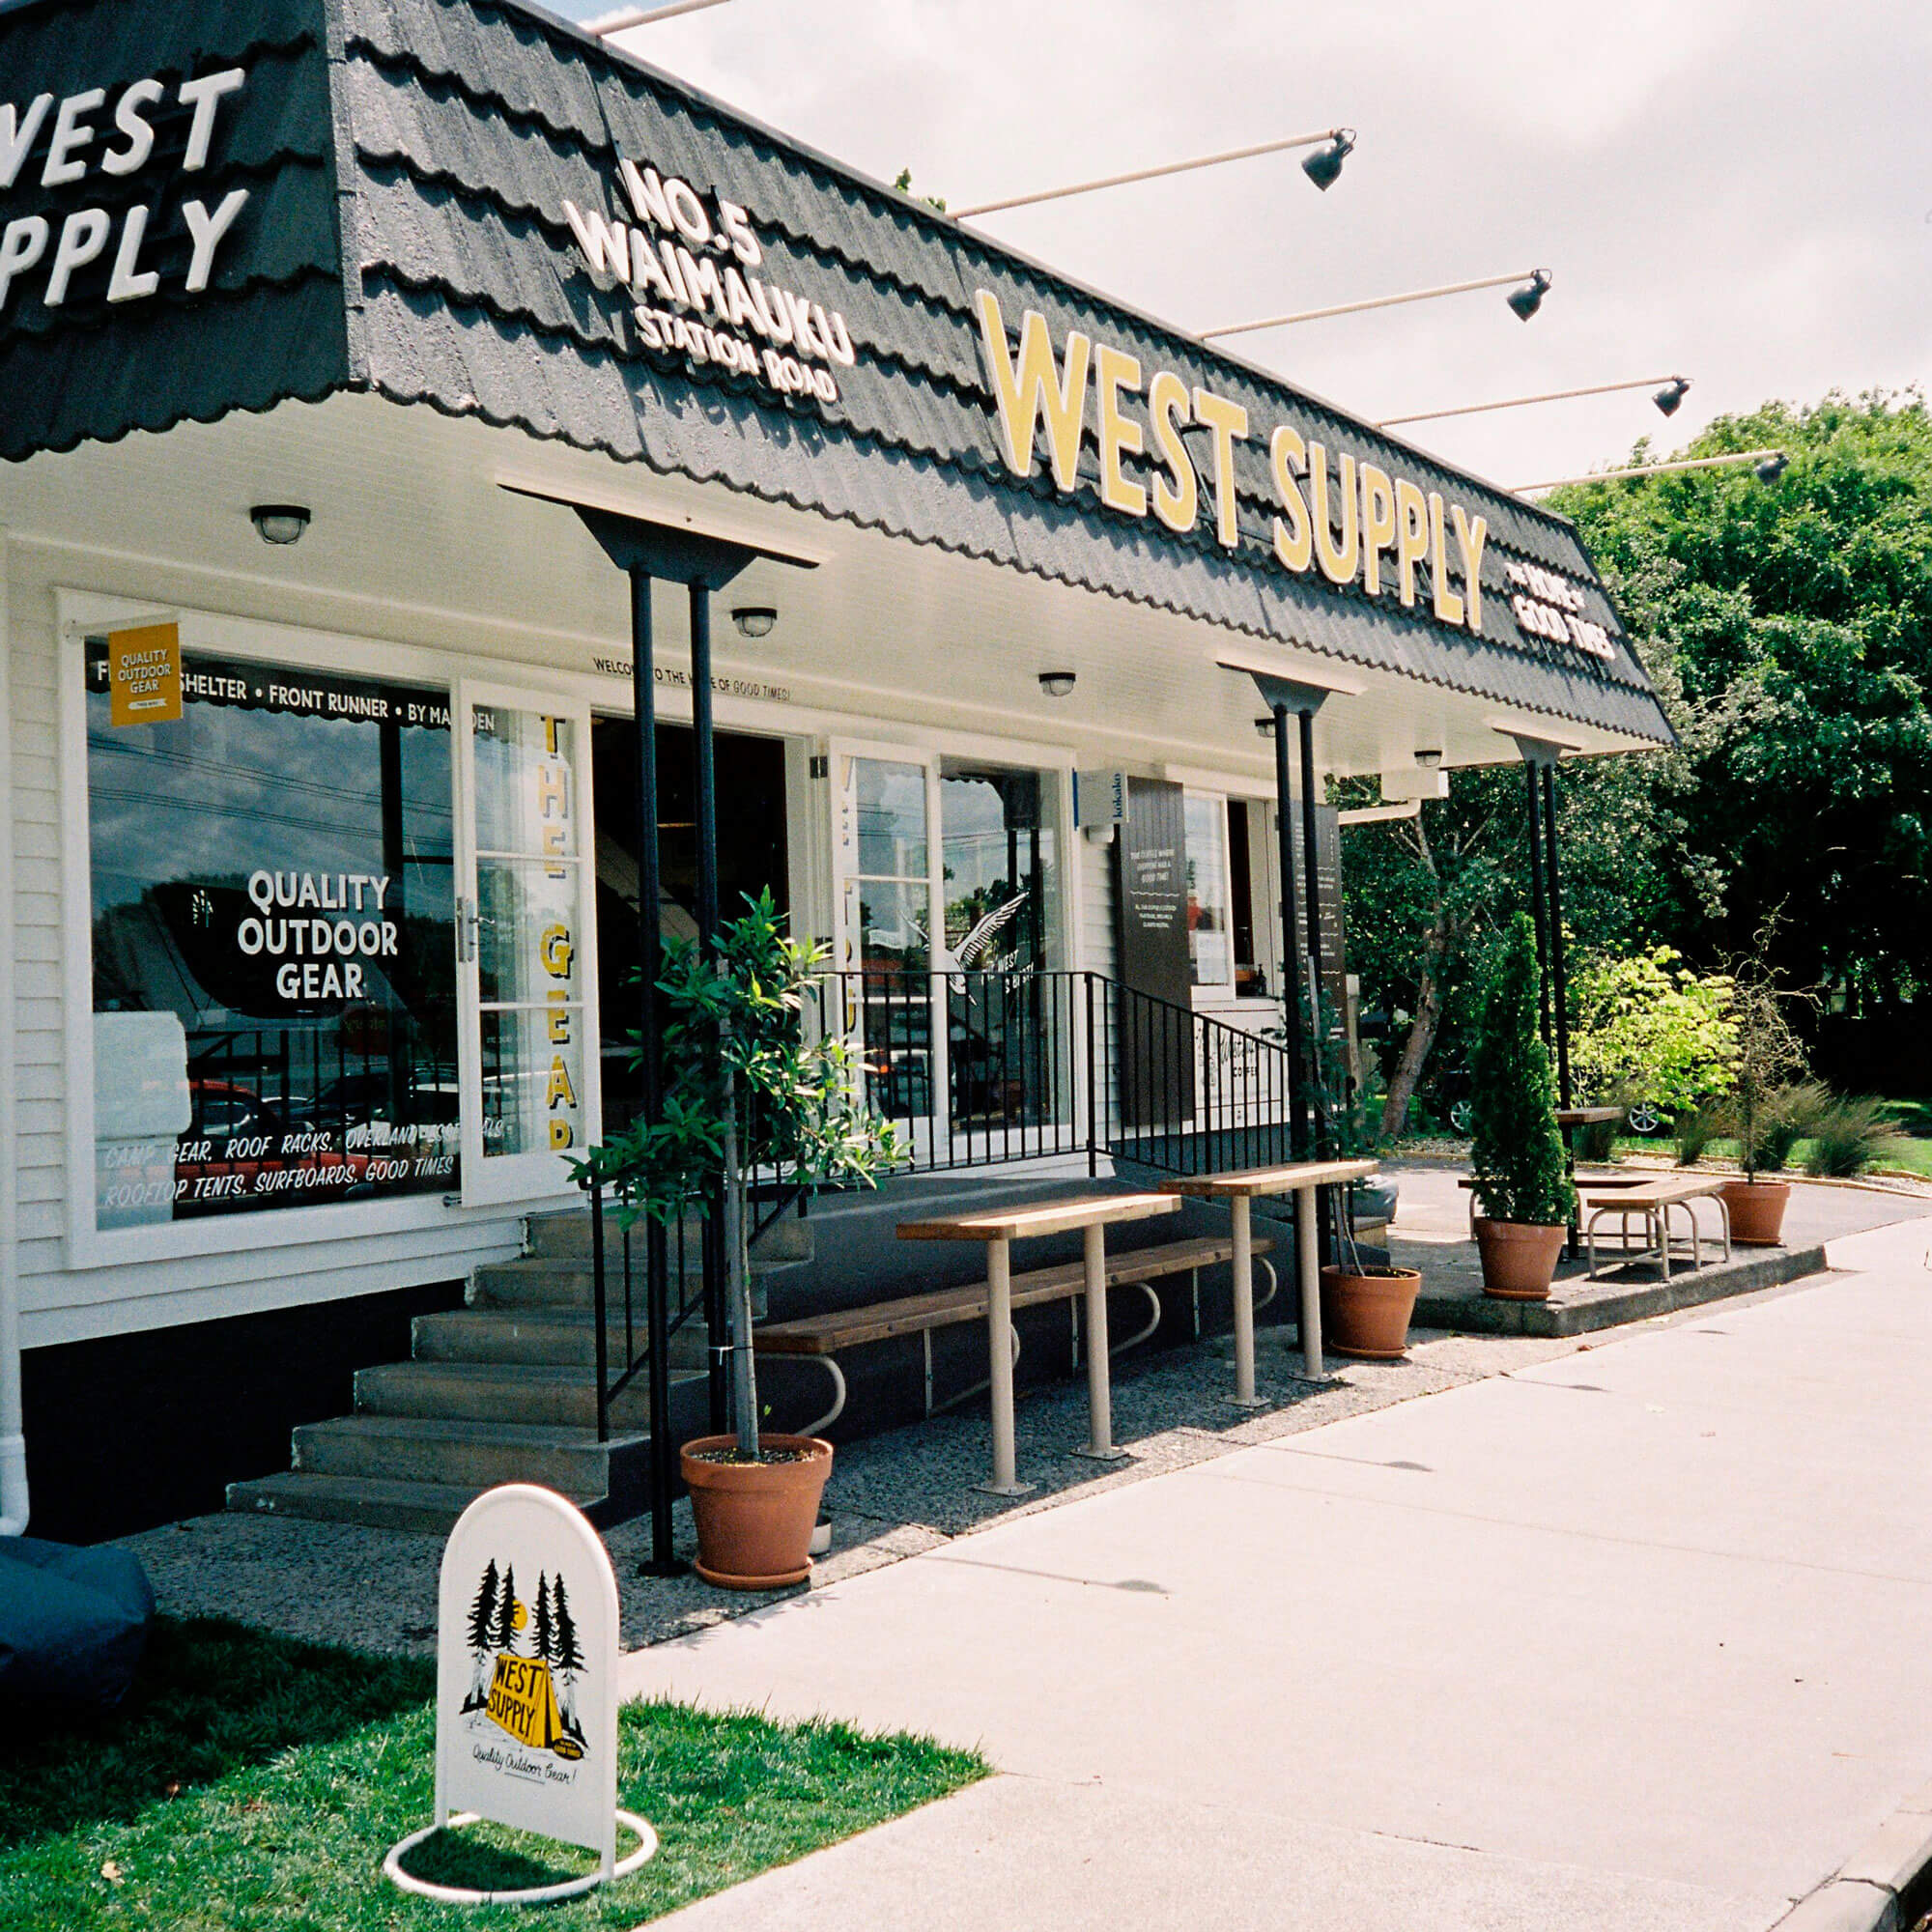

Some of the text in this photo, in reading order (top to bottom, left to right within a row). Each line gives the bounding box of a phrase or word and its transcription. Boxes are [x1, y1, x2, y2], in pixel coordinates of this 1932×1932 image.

[622, 157, 763, 268] NO.5
[561, 199, 856, 366] WAIMAUKU
[634, 304, 838, 403] STATION ROAD
[975, 288, 1487, 631] WEST SUPPLY
[118, 663, 171, 682] OUTDOOR
[122, 649, 168, 668] QUALITY
[593, 657, 635, 675] WELCO
[665, 669, 686, 684] THE
[718, 678, 730, 692] OF
[733, 680, 760, 696] GOOD
[129, 679, 159, 695] GEAR
[270, 684, 324, 709] FRONT
[328, 693, 389, 719] RUNNER
[408, 703, 426, 723] BY
[1112, 773, 1122, 818] kokako
[247, 869, 390, 916] QUALITY
[238, 917, 398, 956] OUTDOOR
[276, 962, 364, 999] GEAR
[225, 1135, 273, 1158] ROOF
[345, 1123, 418, 1150] OVERLAND
[104, 1179, 188, 1207] ROOFTOP
[365, 1159, 410, 1182] GOOD
[413, 1155, 455, 1178] TIMES
[496, 1657, 544, 1699] WEST
[487, 1688, 535, 1738] SUPPLY
[472, 1743, 503, 1772] Quality
[505, 1752, 542, 1777] Outdoor
